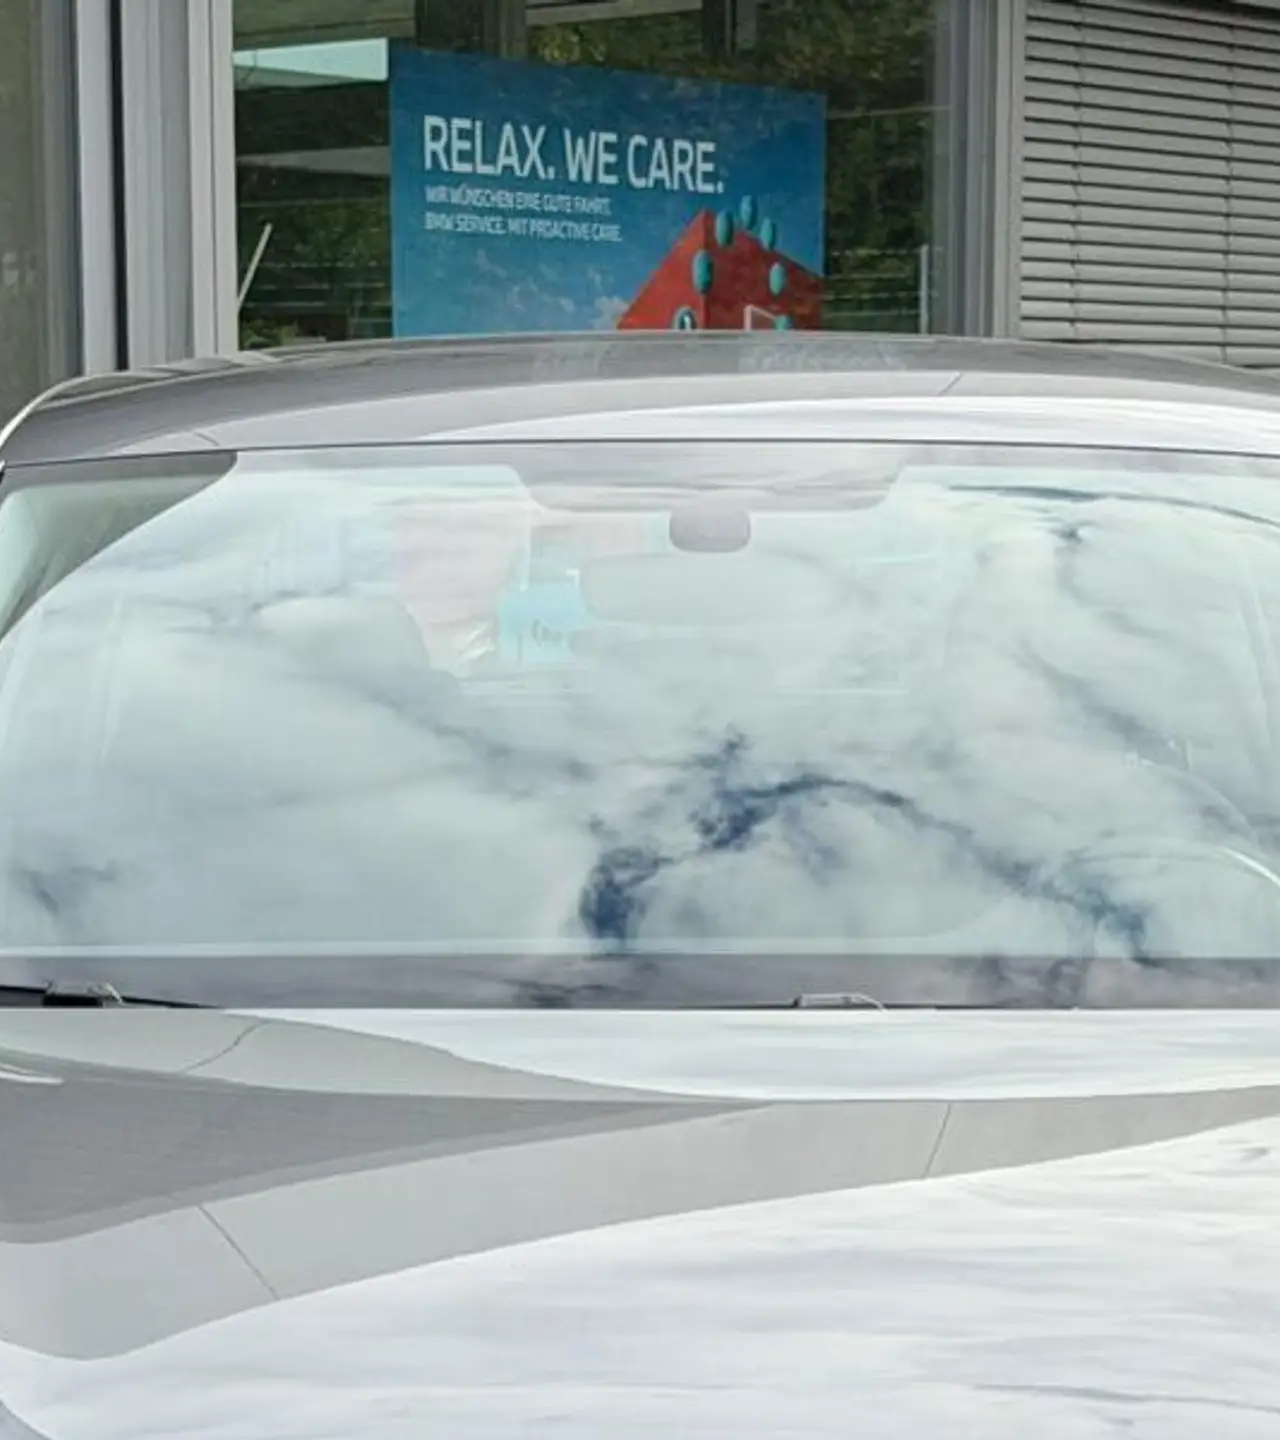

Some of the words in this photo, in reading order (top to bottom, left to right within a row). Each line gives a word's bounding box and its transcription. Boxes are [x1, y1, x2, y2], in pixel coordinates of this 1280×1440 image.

[423, 114, 555, 181] RELAX.
[564, 126, 618, 184] WE
[626, 133, 725, 194] CARE.
